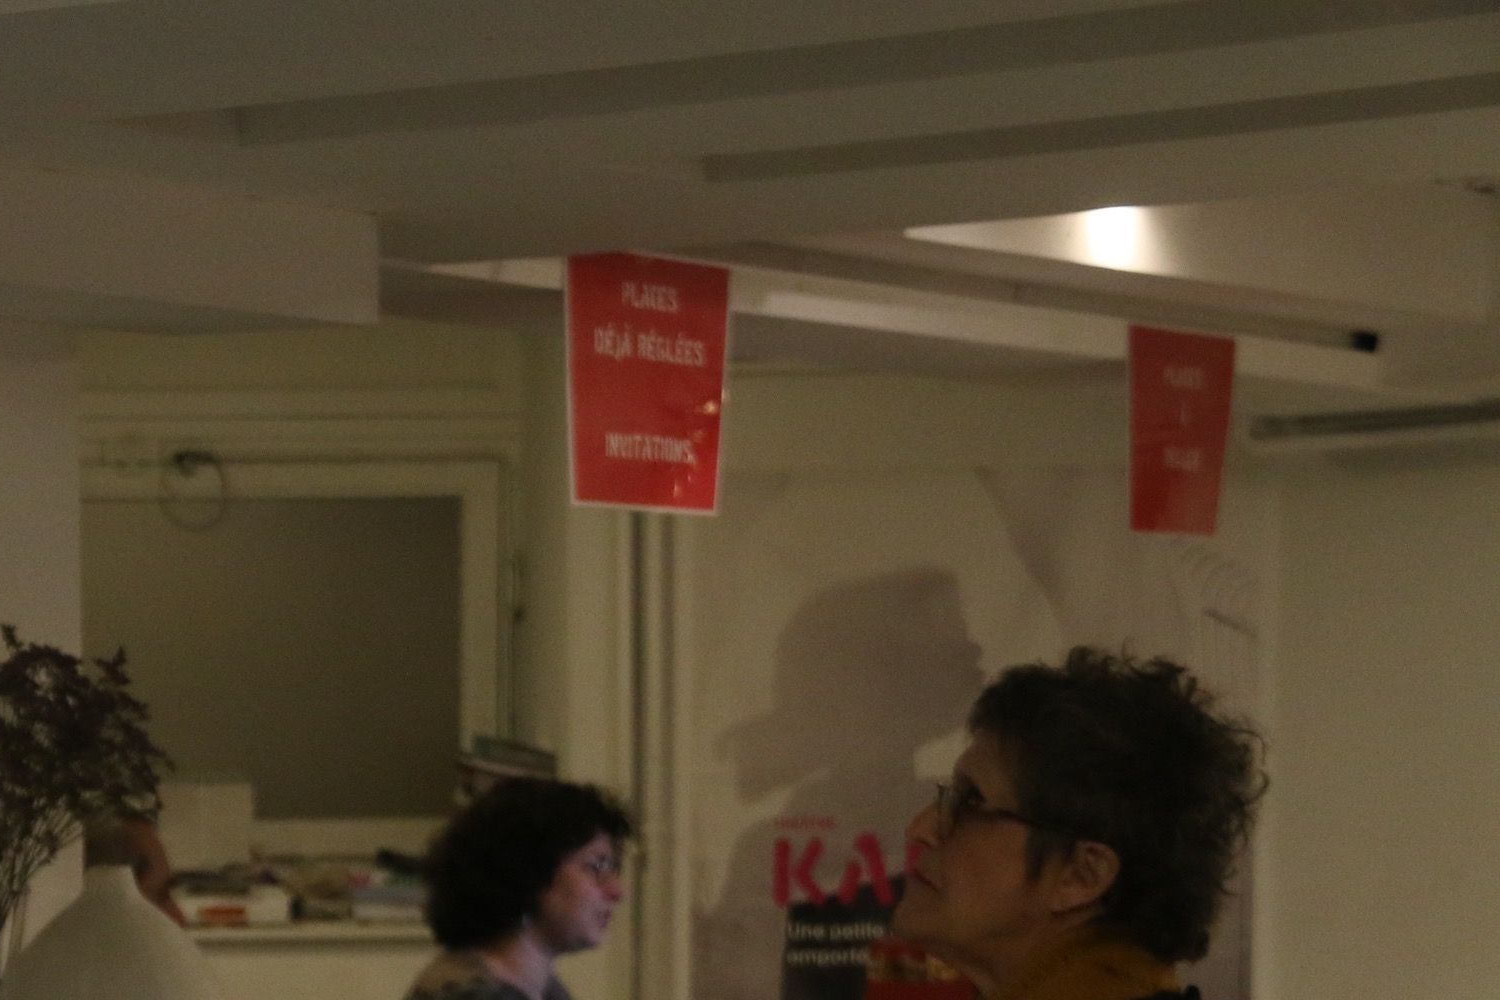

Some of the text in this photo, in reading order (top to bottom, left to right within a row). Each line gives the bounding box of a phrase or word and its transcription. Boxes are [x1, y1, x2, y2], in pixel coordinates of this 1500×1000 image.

[621, 281, 679, 313] PLACES
[605, 432, 697, 466] INVITATIONS
[787, 922, 825, 939] Une
